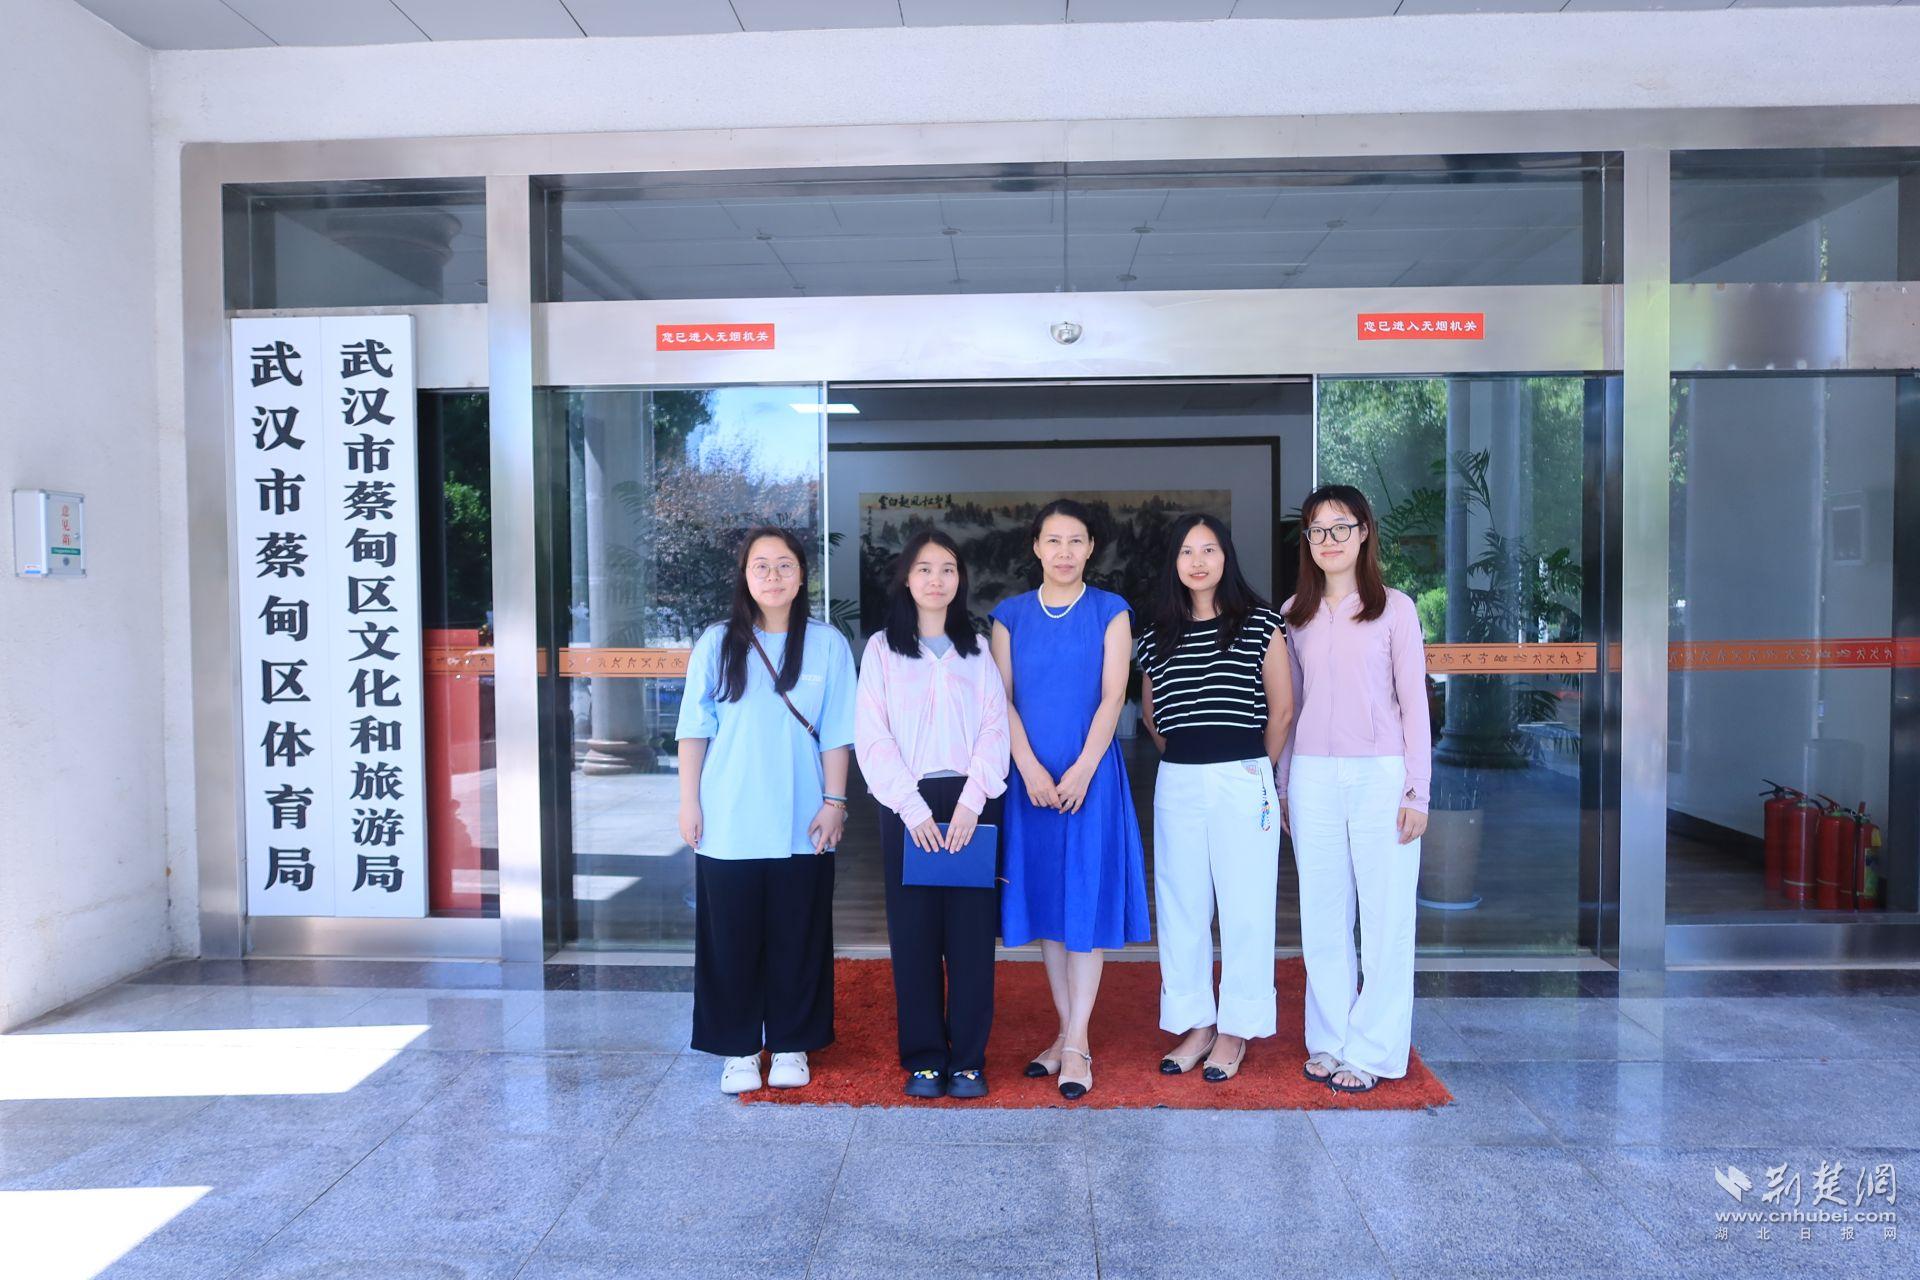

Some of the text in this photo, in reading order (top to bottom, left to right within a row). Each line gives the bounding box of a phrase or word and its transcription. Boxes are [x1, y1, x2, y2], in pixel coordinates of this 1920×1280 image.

[661, 331, 770, 343] 您已进入无烟机关
[1363, 320, 1478, 333] 您已进入无烟机关
[250, 341, 315, 892] 武汉市蔡甸区体育局
[340, 339, 404, 892] 武汉市蔡甸区文化和旅游局
